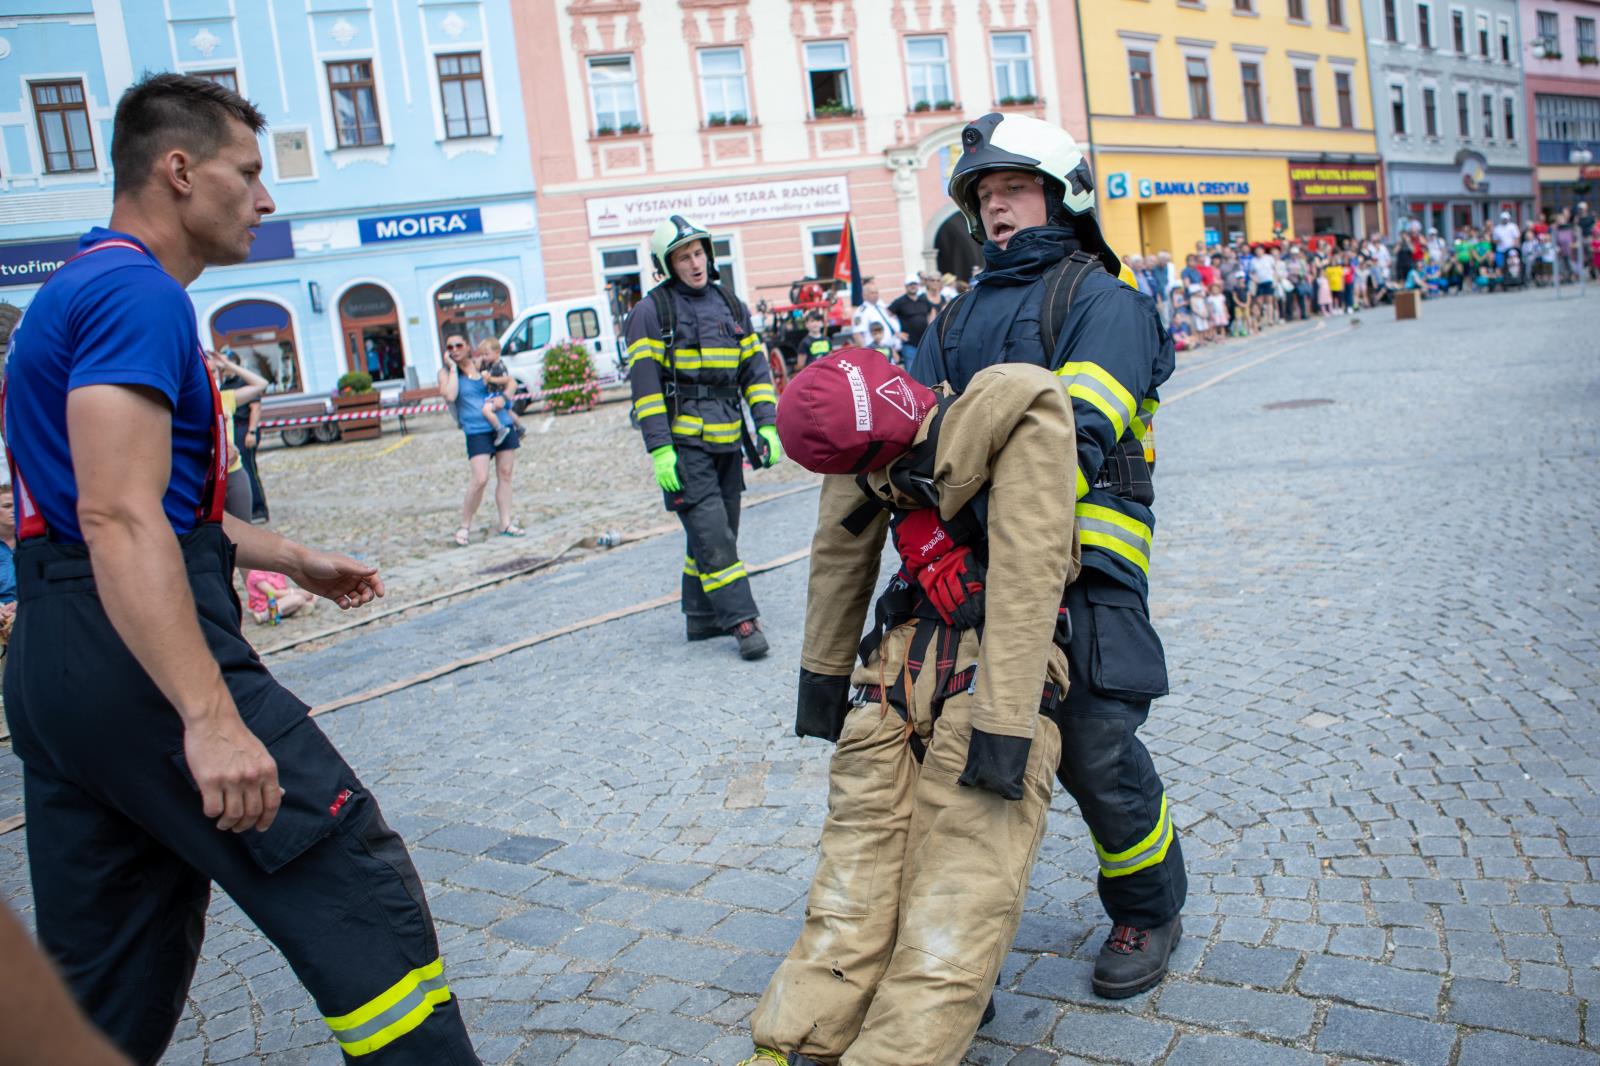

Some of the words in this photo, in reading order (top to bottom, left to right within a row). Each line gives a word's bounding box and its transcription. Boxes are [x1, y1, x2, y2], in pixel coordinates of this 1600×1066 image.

[625, 196, 692, 213] VÝSTAVNÍ
[697, 192, 729, 206] DŮM
[782, 183, 839, 198] RADNICE
[1154, 182, 1195, 195] BANKA
[1197, 182, 1249, 195] CREDITAS
[376, 213, 467, 239] MOIRA
[454, 290, 489, 301] MOIRA
[851, 374, 864, 392] LEE
[856, 395, 868, 426] RUTH
